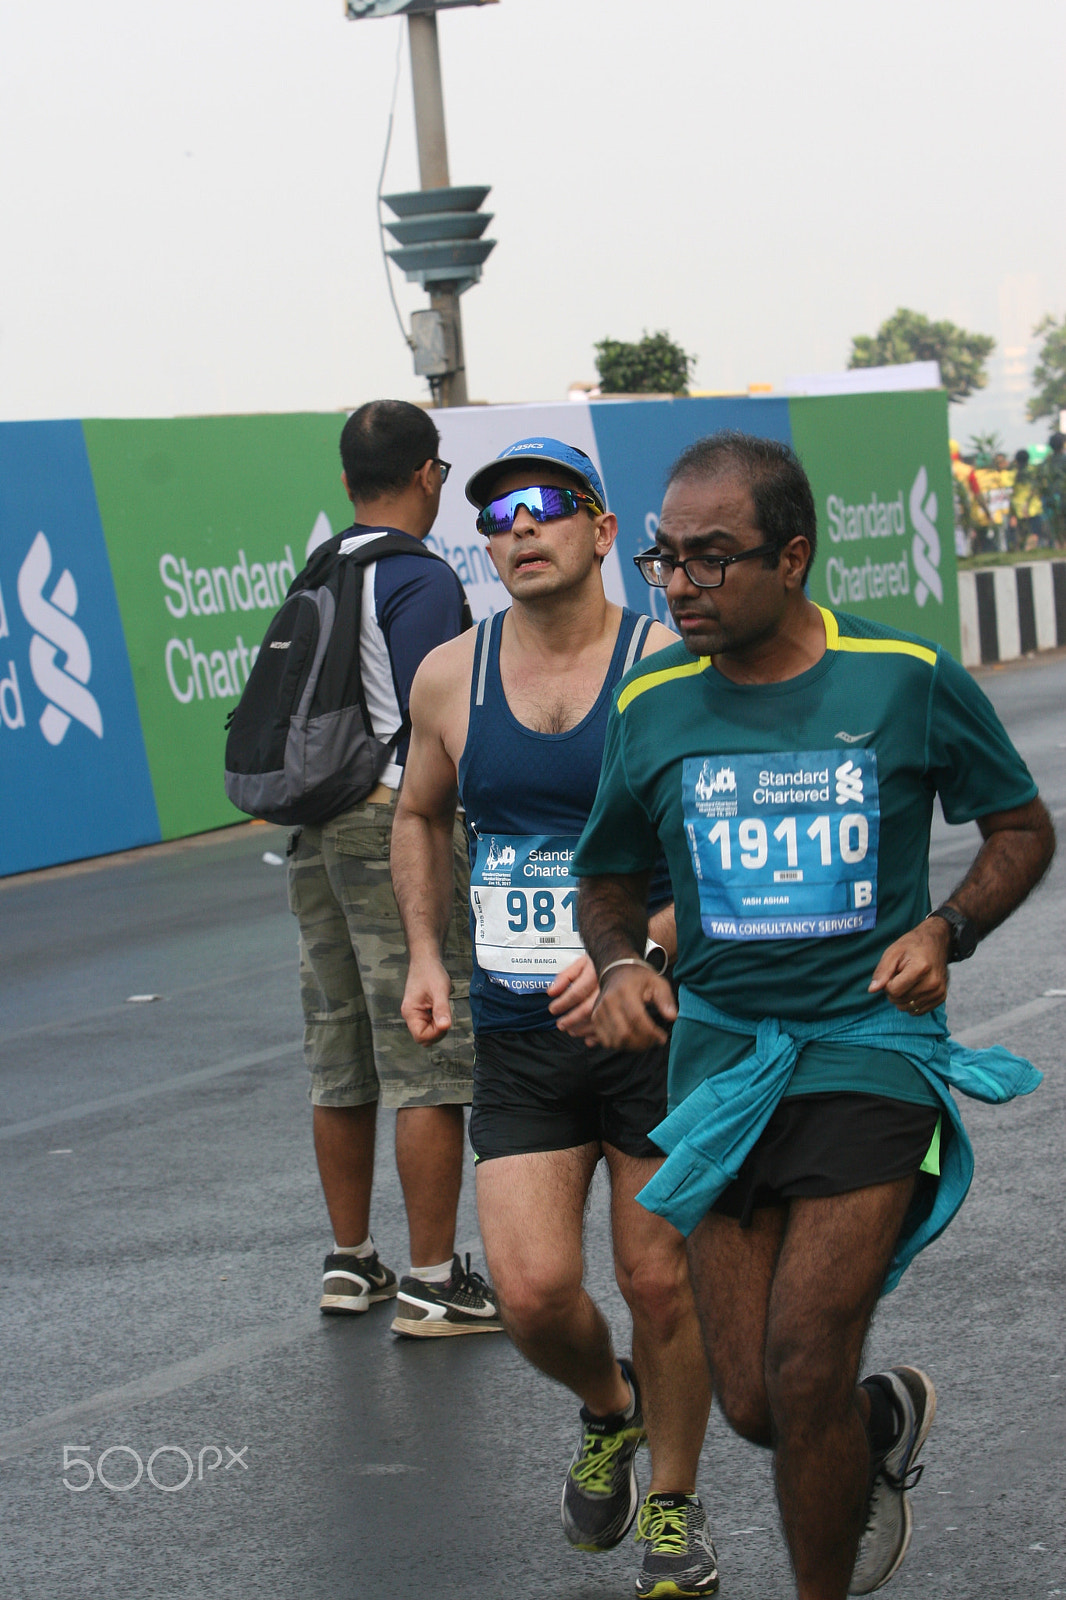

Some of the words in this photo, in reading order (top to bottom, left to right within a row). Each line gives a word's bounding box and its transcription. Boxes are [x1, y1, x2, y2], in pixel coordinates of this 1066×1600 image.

[826, 489, 906, 543] Standard
[825, 549, 910, 606] Chartered
[758, 768, 829, 787] Standard
[752, 786, 830, 805] Chartered
[707, 813, 869, 870] 19110
[523, 864, 570, 877] Charte
[853, 880, 873, 909] B
[711, 922, 737, 935] TATA
[738, 921, 816, 935] CONSULTANCY
[818, 915, 864, 932] SERVICES
